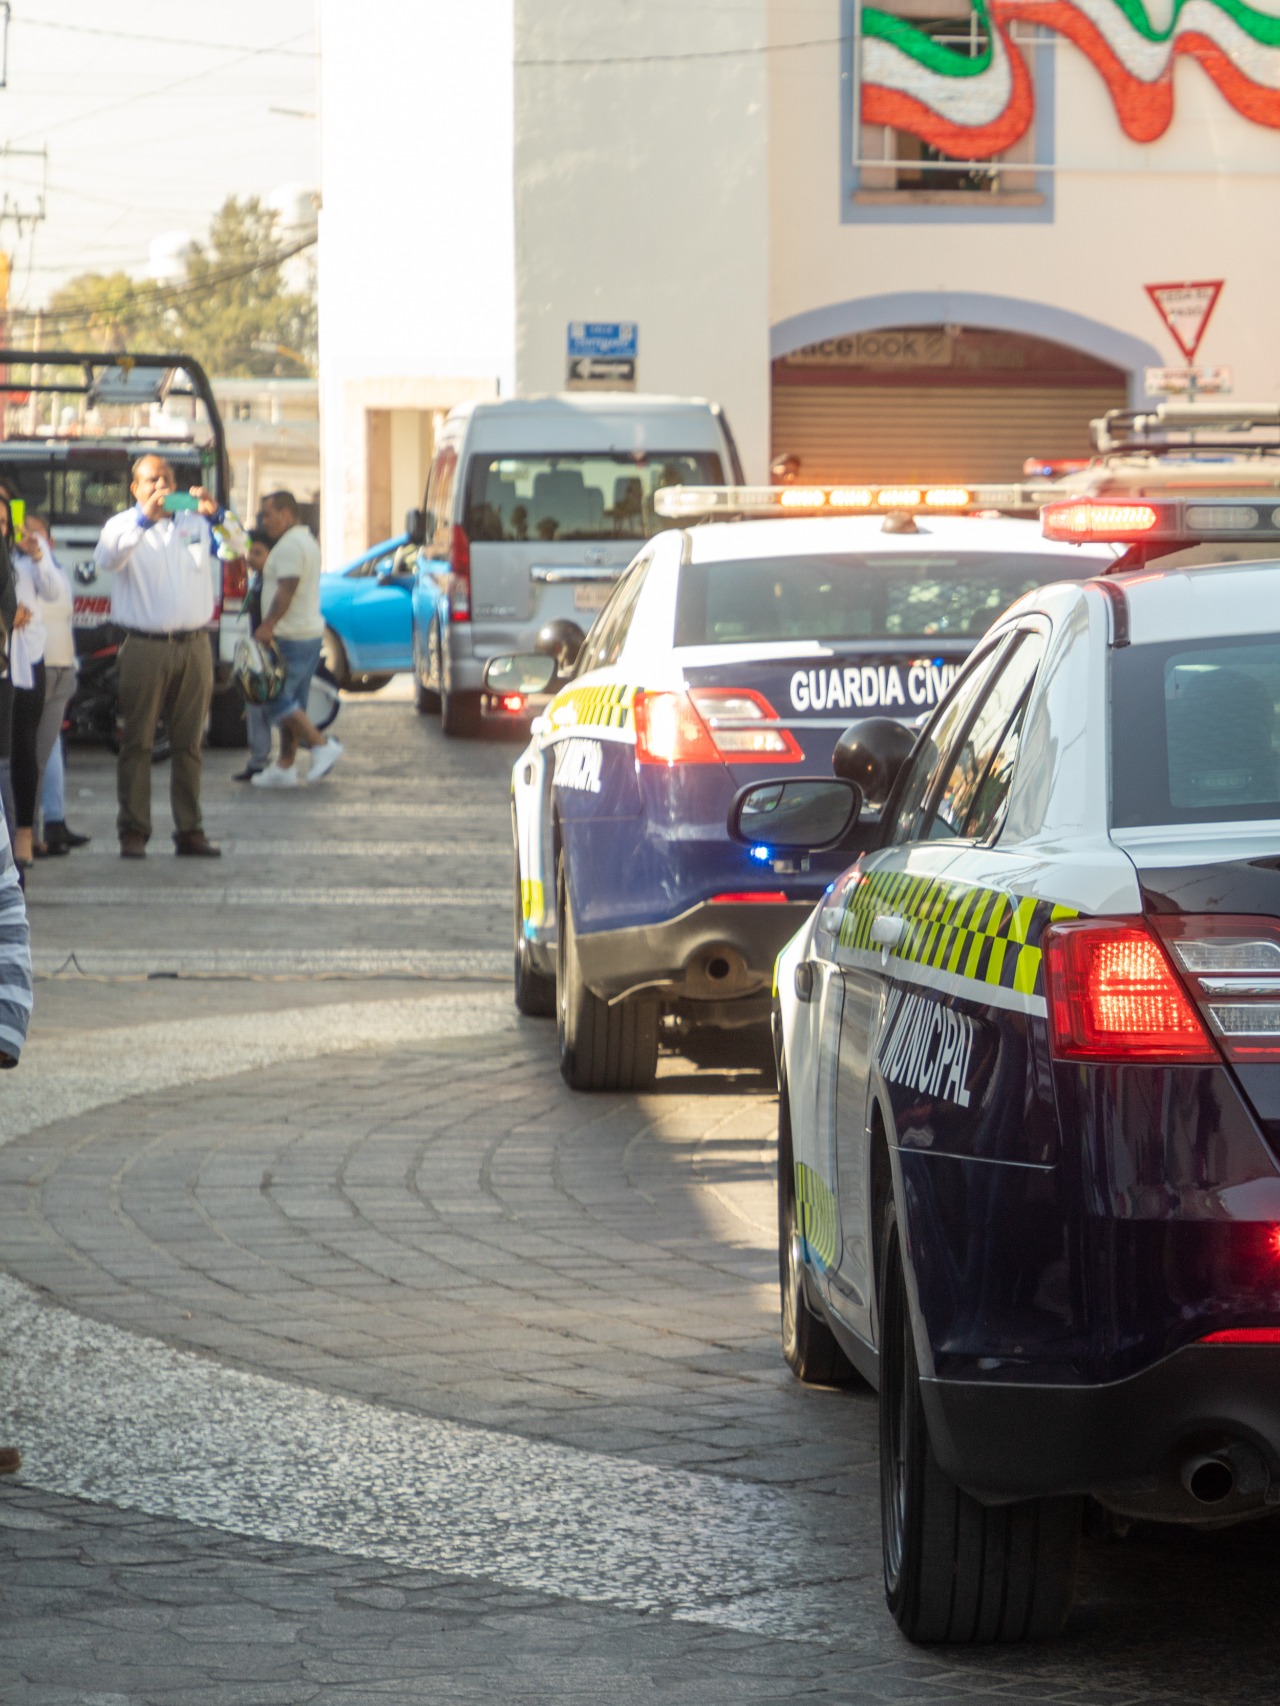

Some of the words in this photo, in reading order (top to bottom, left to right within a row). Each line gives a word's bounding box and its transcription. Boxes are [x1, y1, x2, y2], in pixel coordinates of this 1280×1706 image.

[791, 332, 919, 357] acelook
[790, 666, 905, 711] GUARDIA
[908, 664, 961, 704] CIVI
